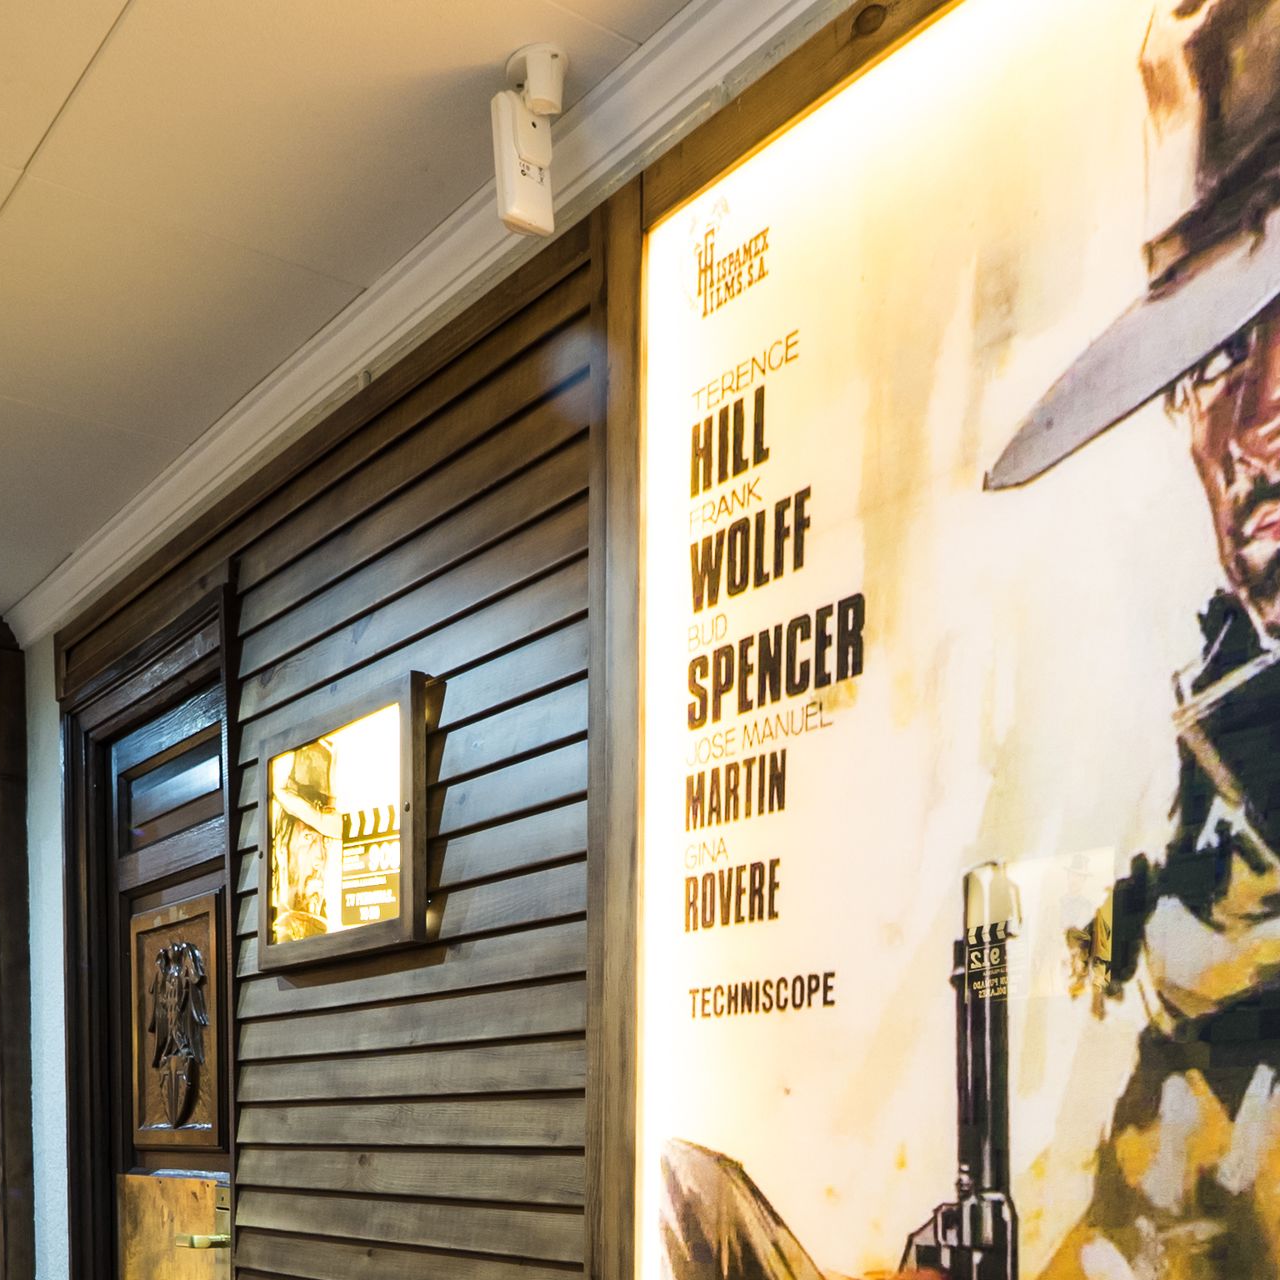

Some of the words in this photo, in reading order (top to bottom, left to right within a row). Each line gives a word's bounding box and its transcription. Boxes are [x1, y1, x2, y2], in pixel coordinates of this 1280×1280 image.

[692, 328, 799, 411] TERENCE
[690, 385, 769, 499] HILL
[689, 476, 763, 537] FRANK
[690, 484, 812, 614] WOLFF
[687, 592, 865, 732] SPENCER
[688, 613, 728, 653] BUD
[686, 728, 736, 768] JOSE
[742, 701, 833, 750] MANUEL
[685, 748, 787, 832] MARTIN
[684, 837, 729, 870] GINA
[685, 858, 781, 933] ROVERE
[688, 971, 836, 1019] TECHNISCOPE
